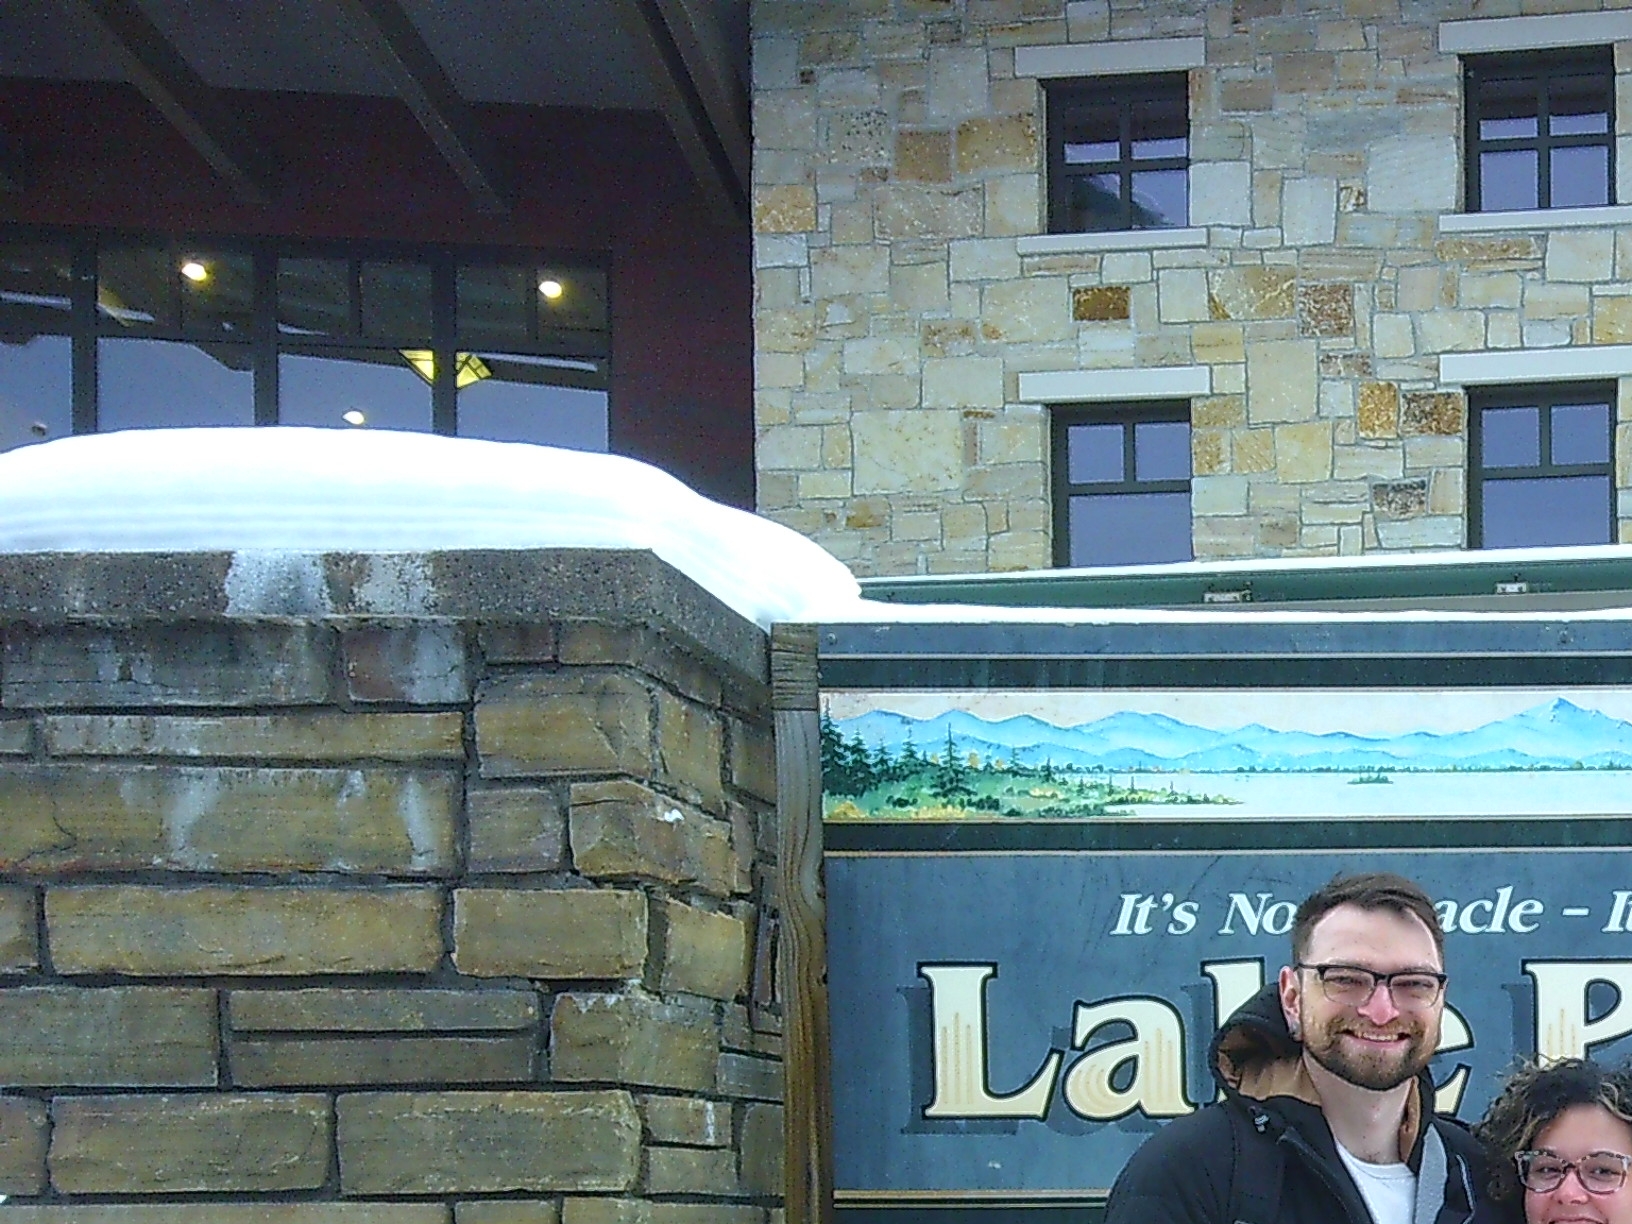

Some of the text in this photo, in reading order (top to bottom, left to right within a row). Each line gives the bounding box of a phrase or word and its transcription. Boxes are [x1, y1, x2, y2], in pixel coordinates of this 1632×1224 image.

[1109, 893, 1200, 936] It's
[1433, 884, 1545, 934] acle
[917, 957, 1474, 1120] La
